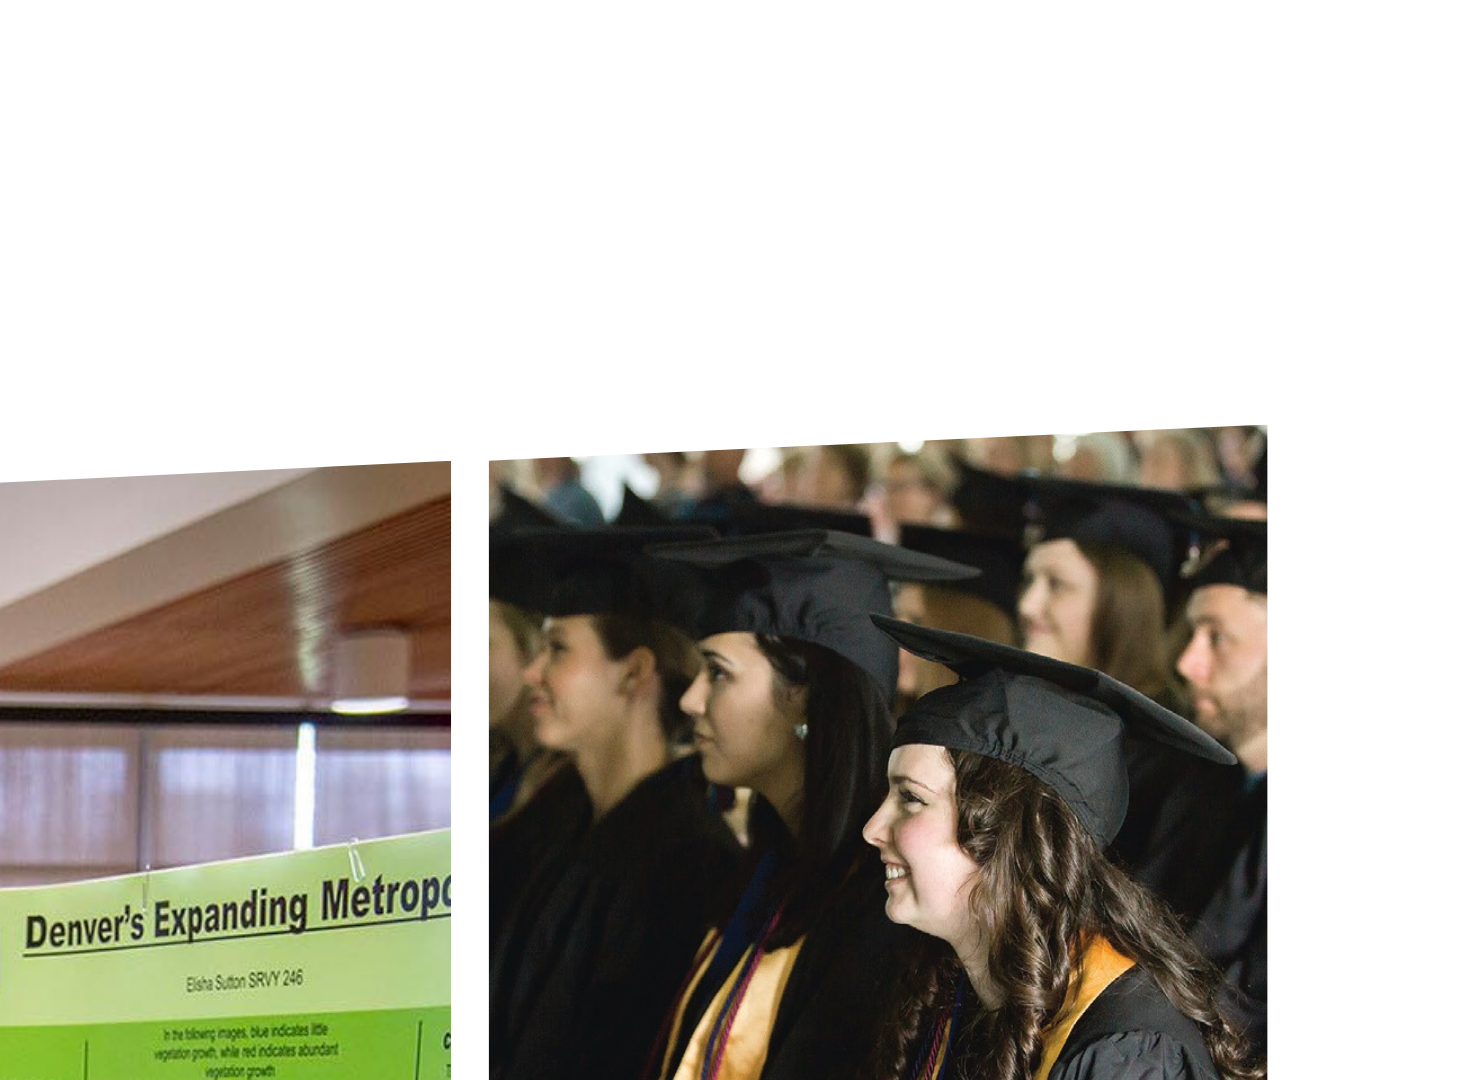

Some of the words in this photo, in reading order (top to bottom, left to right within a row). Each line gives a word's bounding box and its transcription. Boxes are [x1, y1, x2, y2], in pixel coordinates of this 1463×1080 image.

[25, 904, 144, 949] Denver’s
[154, 888, 308, 943] Expanding
[186, 976, 213, 992] Elisha
[215, 974, 246, 990] Sutton
[248, 970, 280, 988] SRVY
[283, 970, 303, 986] 246
[186, 1028, 215, 1042] following
[218, 1028, 248, 1042] images,
[250, 1027, 268, 1038] blue
[272, 1025, 308, 1037] indicates
[242, 1045, 256, 1057] red
[259, 1044, 296, 1056] indicates
[298, 1043, 338, 1055] abundant
[205, 1066, 244, 1080] vegetation
[247, 1065, 275, 1080] growth
